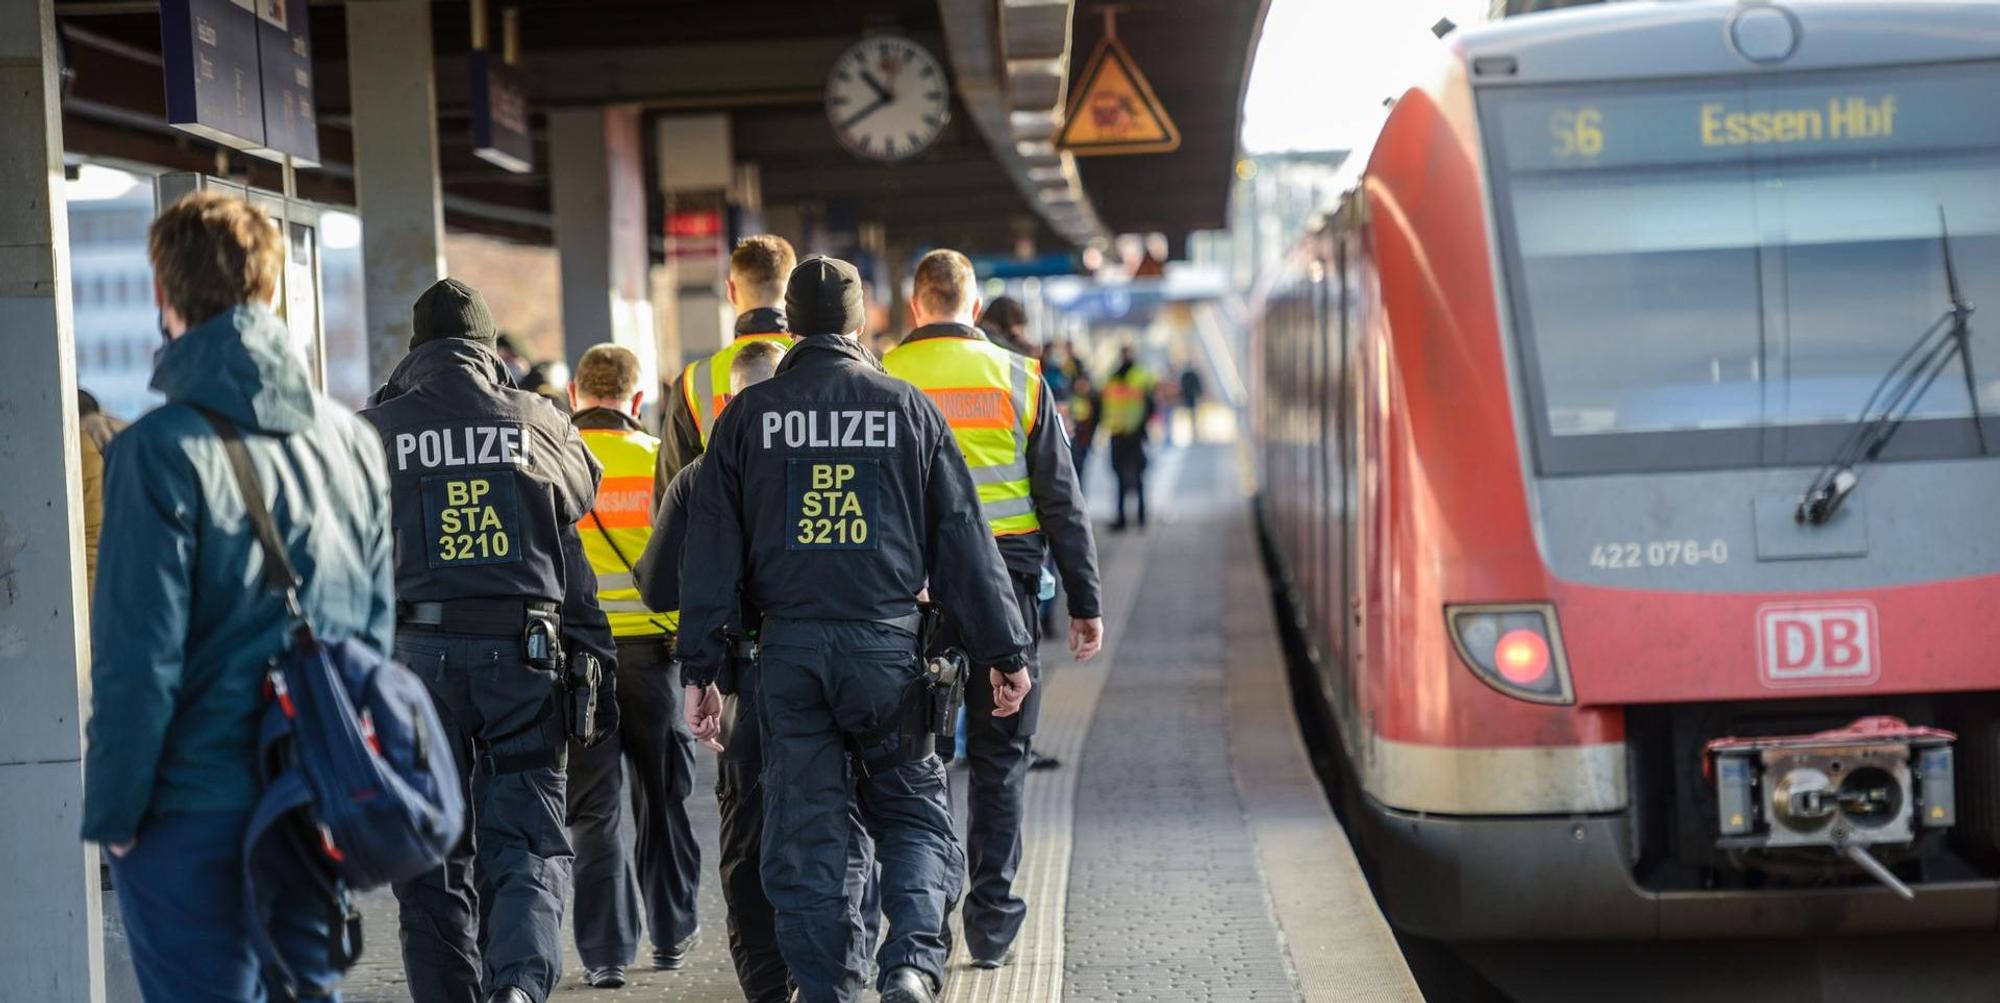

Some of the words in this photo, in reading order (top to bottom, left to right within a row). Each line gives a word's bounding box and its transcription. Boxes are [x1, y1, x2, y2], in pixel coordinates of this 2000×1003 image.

[1550, 106, 1604, 157] S6
[1702, 103, 1823, 147] Essen
[1828, 96, 1896, 140] Hbf
[762, 411, 896, 449] POLIZEI
[396, 426, 530, 471] POLIZEI
[812, 464, 855, 489] BP
[447, 479, 490, 506] BP
[802, 491, 863, 517] STA
[441, 505, 503, 533] STA
[797, 518, 867, 544] 3210
[438, 531, 509, 561] 3210
[1590, 543, 1642, 569] 422
[1772, 616, 1866, 672] DB
